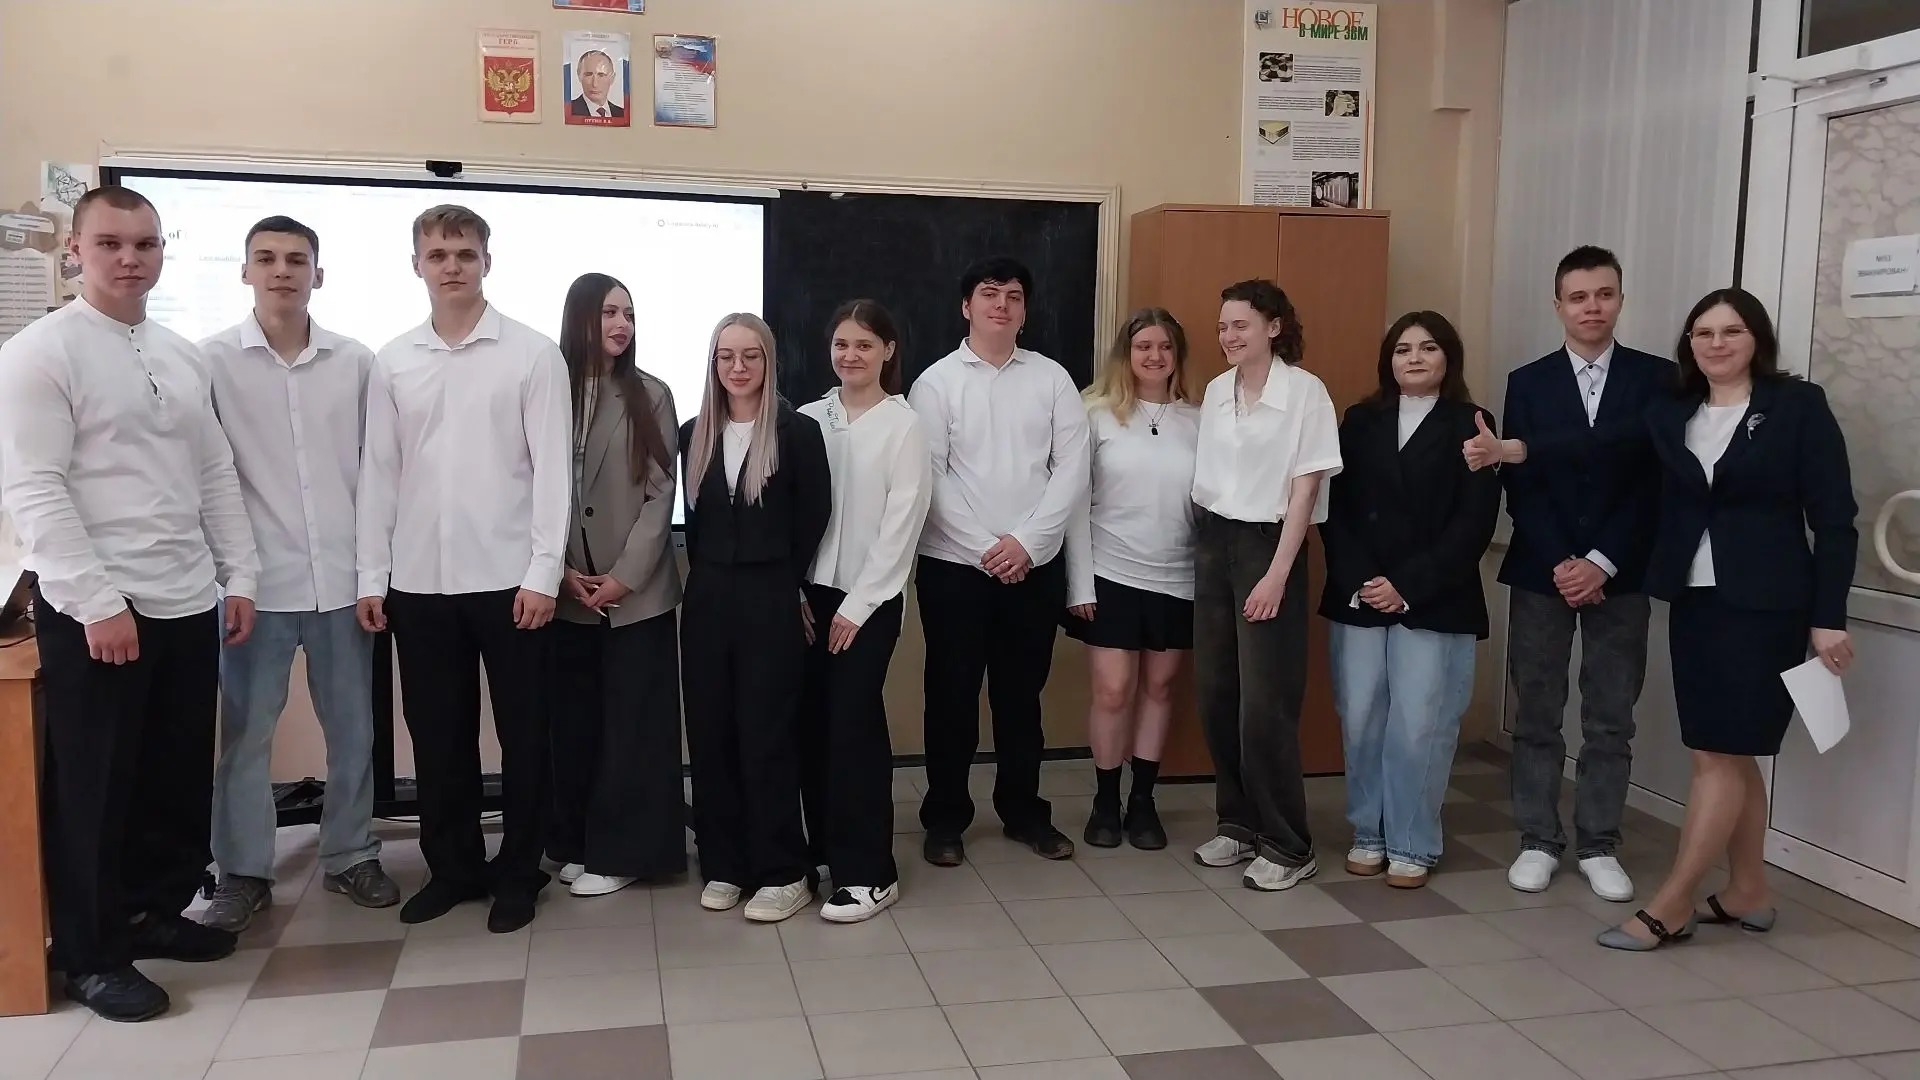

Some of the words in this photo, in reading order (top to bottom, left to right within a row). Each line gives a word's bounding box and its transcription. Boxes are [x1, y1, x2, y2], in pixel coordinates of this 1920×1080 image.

[1282, 8, 1364, 32] НОВОЕ
[1299, 23, 1306, 38] В
[1310, 24, 1340, 39] МИРЕ
[1344, 25, 1369, 41] ЭВМ
